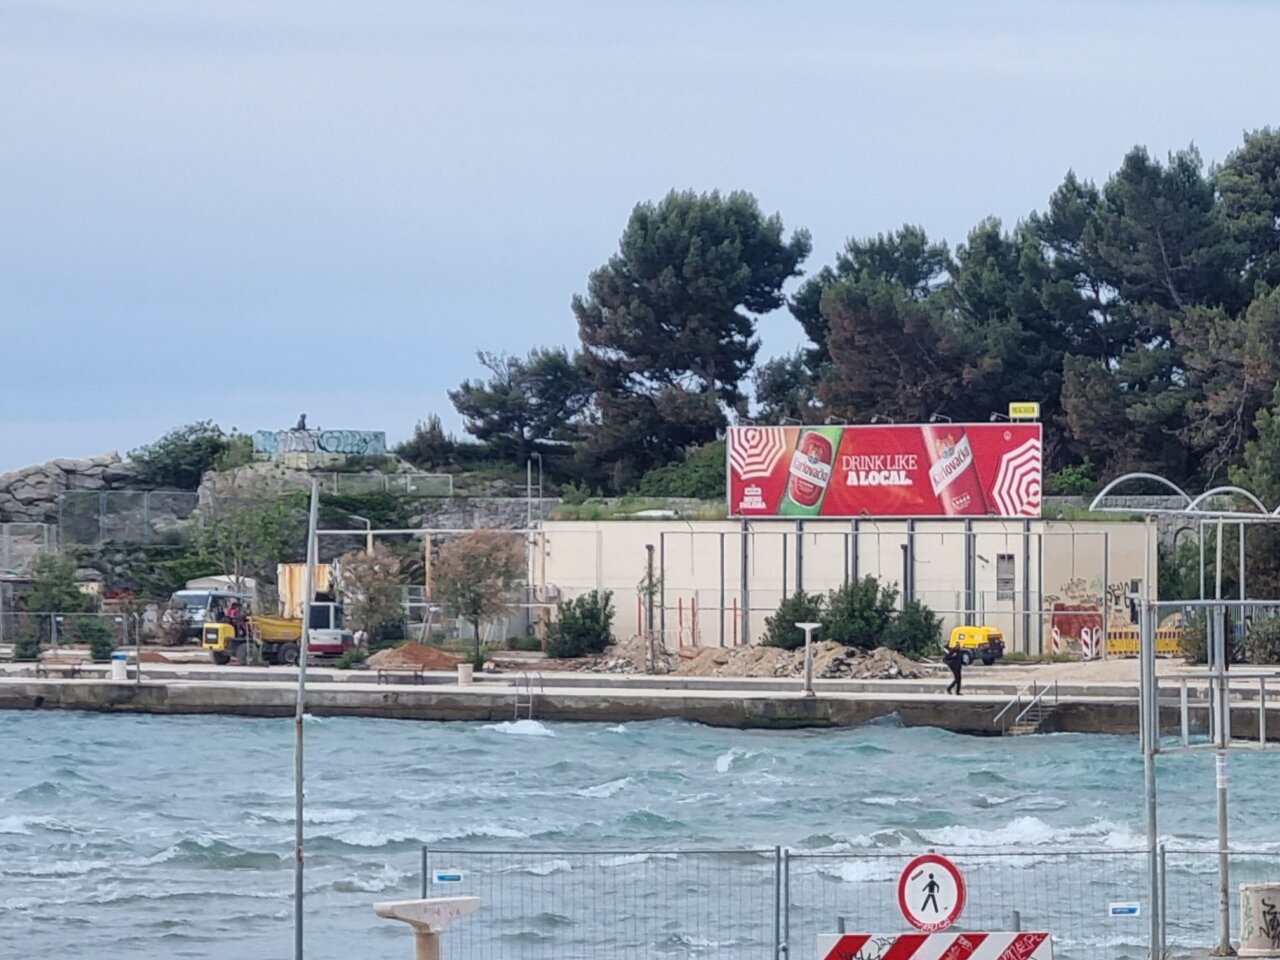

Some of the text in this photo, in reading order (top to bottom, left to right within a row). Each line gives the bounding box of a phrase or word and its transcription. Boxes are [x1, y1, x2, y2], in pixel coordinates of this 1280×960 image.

[842, 454, 918, 470] DRINK LIKE
[846, 470, 859, 486] A
